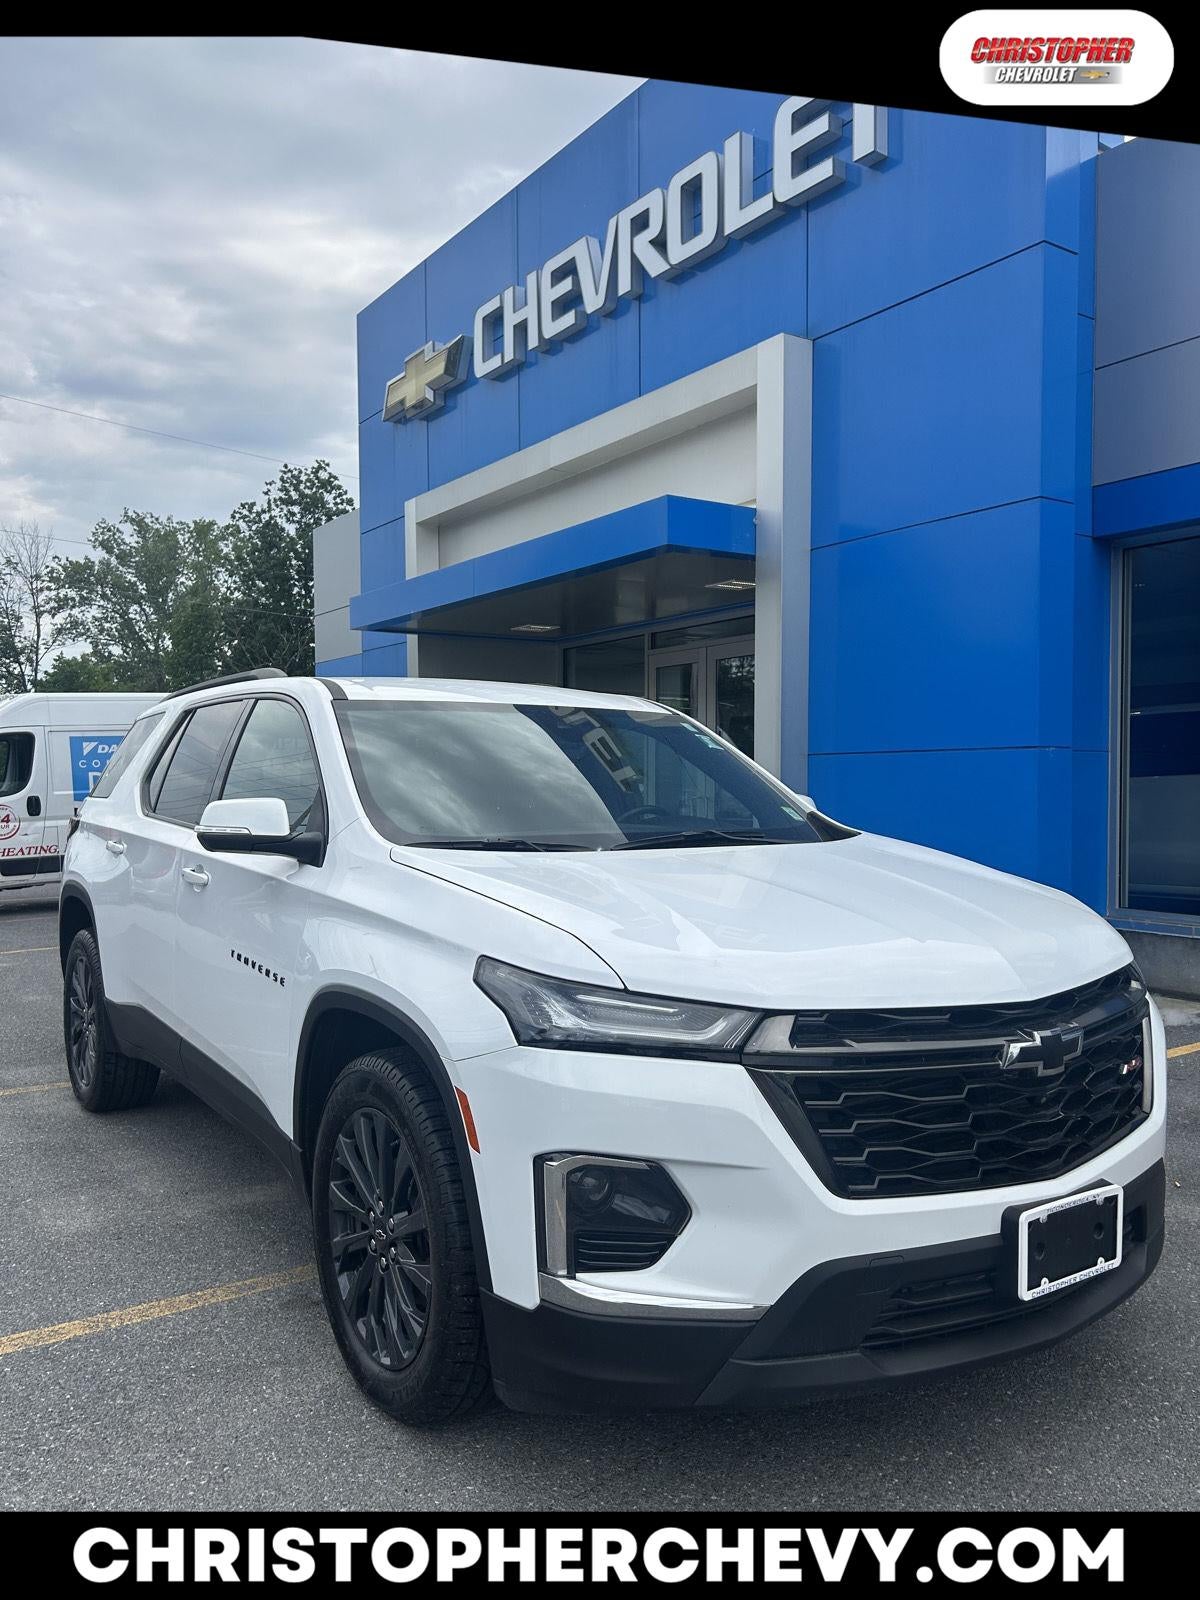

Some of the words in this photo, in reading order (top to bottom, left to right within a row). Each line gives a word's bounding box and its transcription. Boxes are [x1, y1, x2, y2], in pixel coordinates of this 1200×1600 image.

[231, 948, 286, 987] TRAVERSE
[1031, 1276, 1077, 1298] CHRISTOPHER
[1079, 1262, 1115, 1281] CHEVROLET
